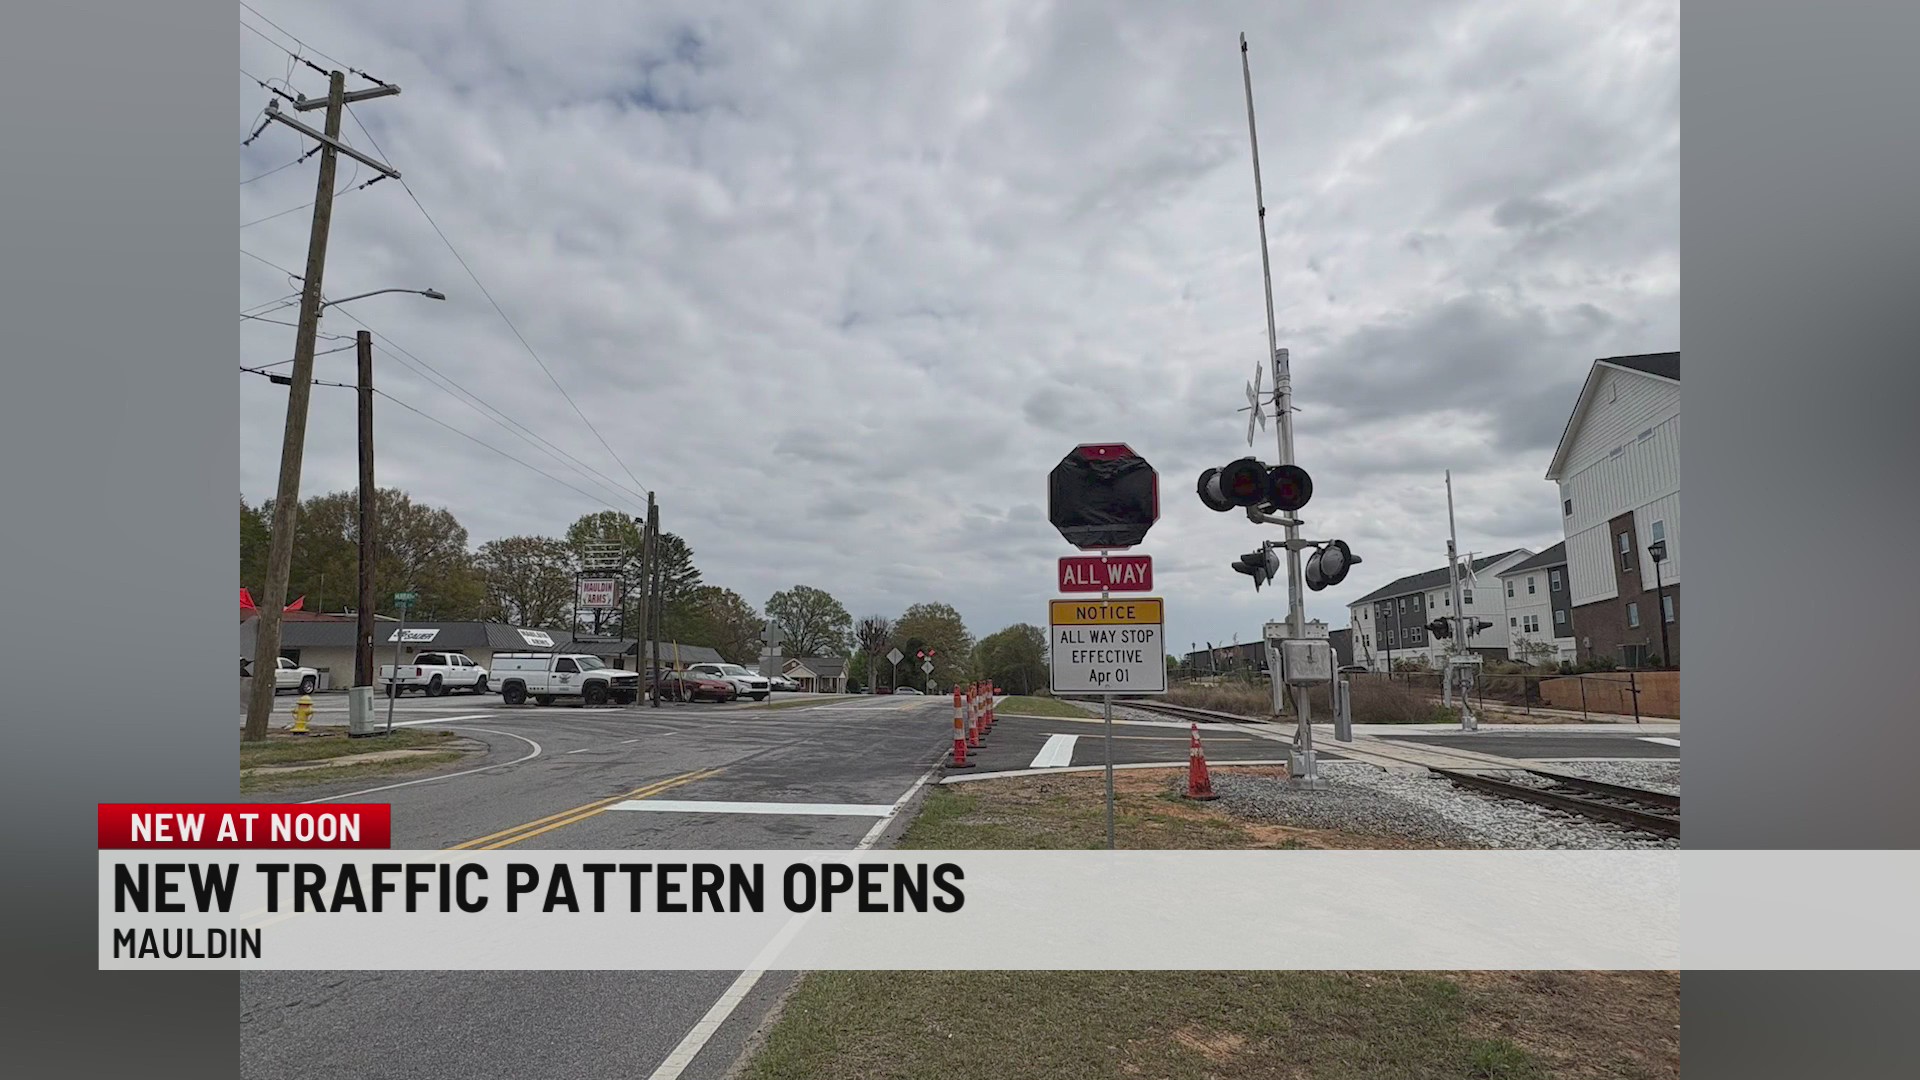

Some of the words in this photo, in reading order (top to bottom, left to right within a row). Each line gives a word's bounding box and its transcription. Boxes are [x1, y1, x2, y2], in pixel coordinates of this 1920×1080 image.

[1063, 564, 1101, 585] ALL
[1107, 563, 1147, 584] WAY
[583, 582, 613, 592] MAULDIN
[587, 594, 607, 603] ARMS
[1076, 606, 1136, 620] NOTICE
[1060, 631, 1085, 644] ALL
[1090, 630, 1117, 643] WAY
[1121, 629, 1154, 643] STOP
[1072, 650, 1143, 664] EFFECTIVE
[1089, 669, 1111, 687] Apr
[1115, 668, 1129, 682] 01
